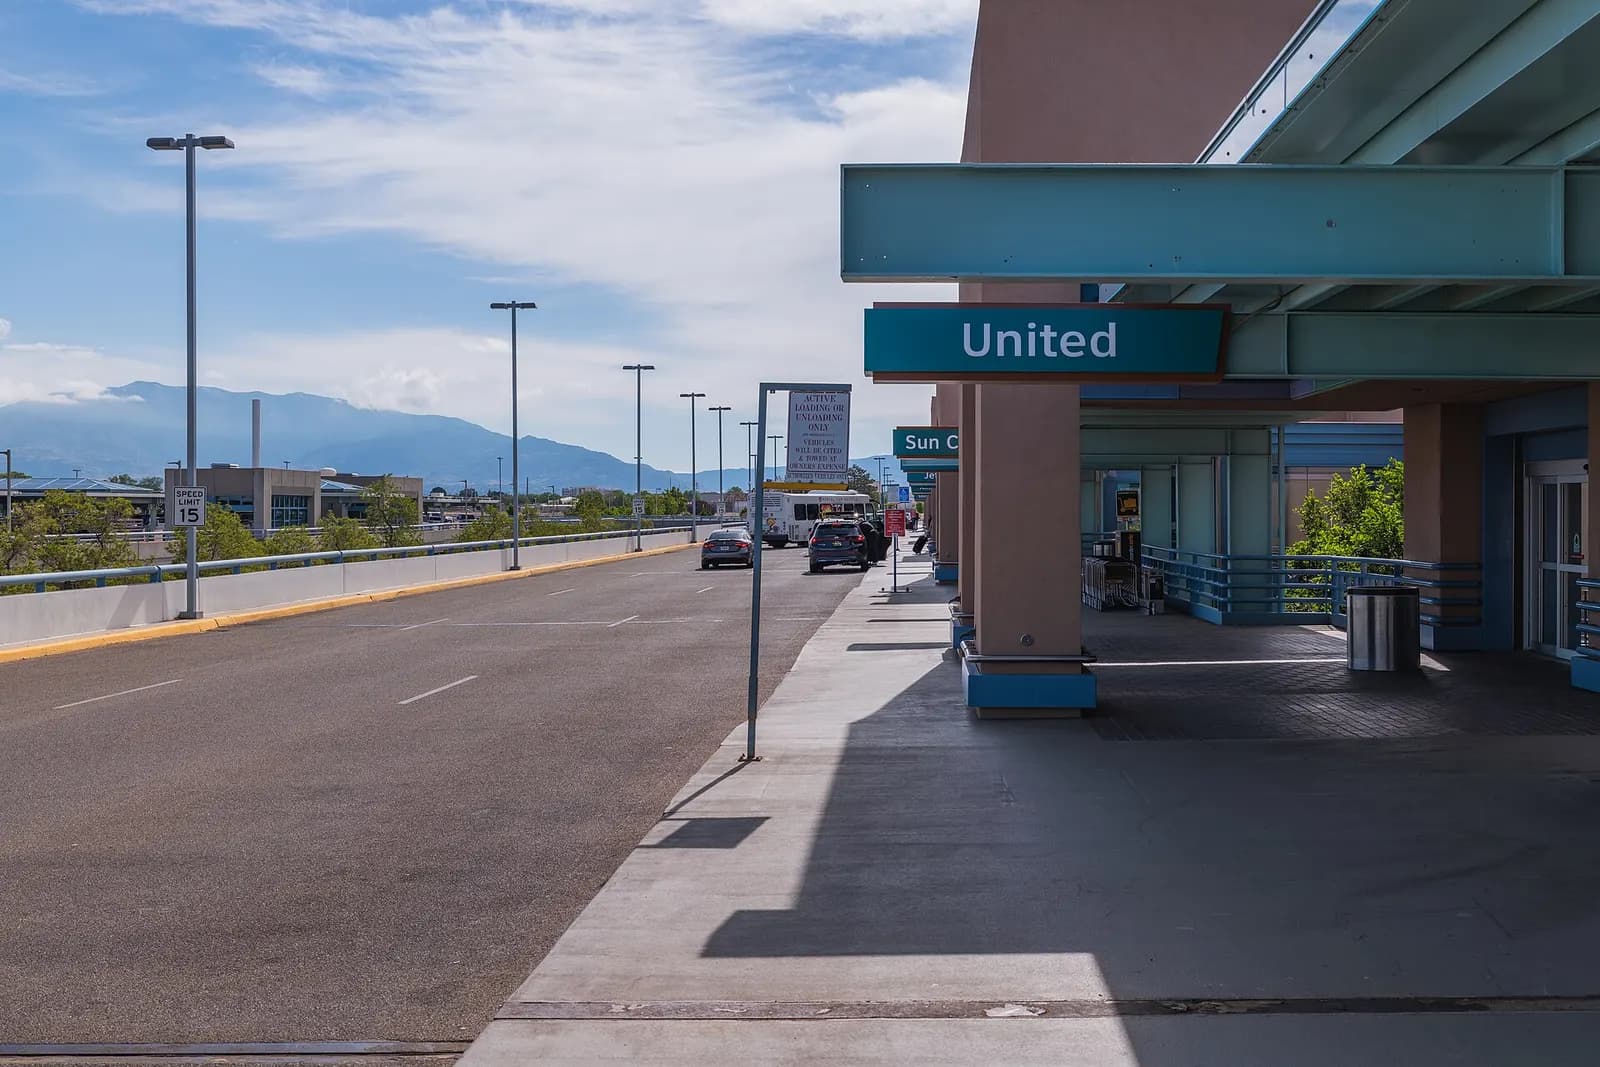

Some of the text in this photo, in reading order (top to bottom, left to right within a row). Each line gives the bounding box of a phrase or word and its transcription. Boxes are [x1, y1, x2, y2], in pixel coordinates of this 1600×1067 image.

[963, 322, 1117, 358] United
[795, 403, 844, 412] LOADING OR
[796, 413, 843, 422] UNLOADING
[808, 424, 829, 432] ONLY
[905, 435, 939, 449] Sun
[817, 463, 845, 471] EXPENSE
[180, 509, 199, 522] 15
